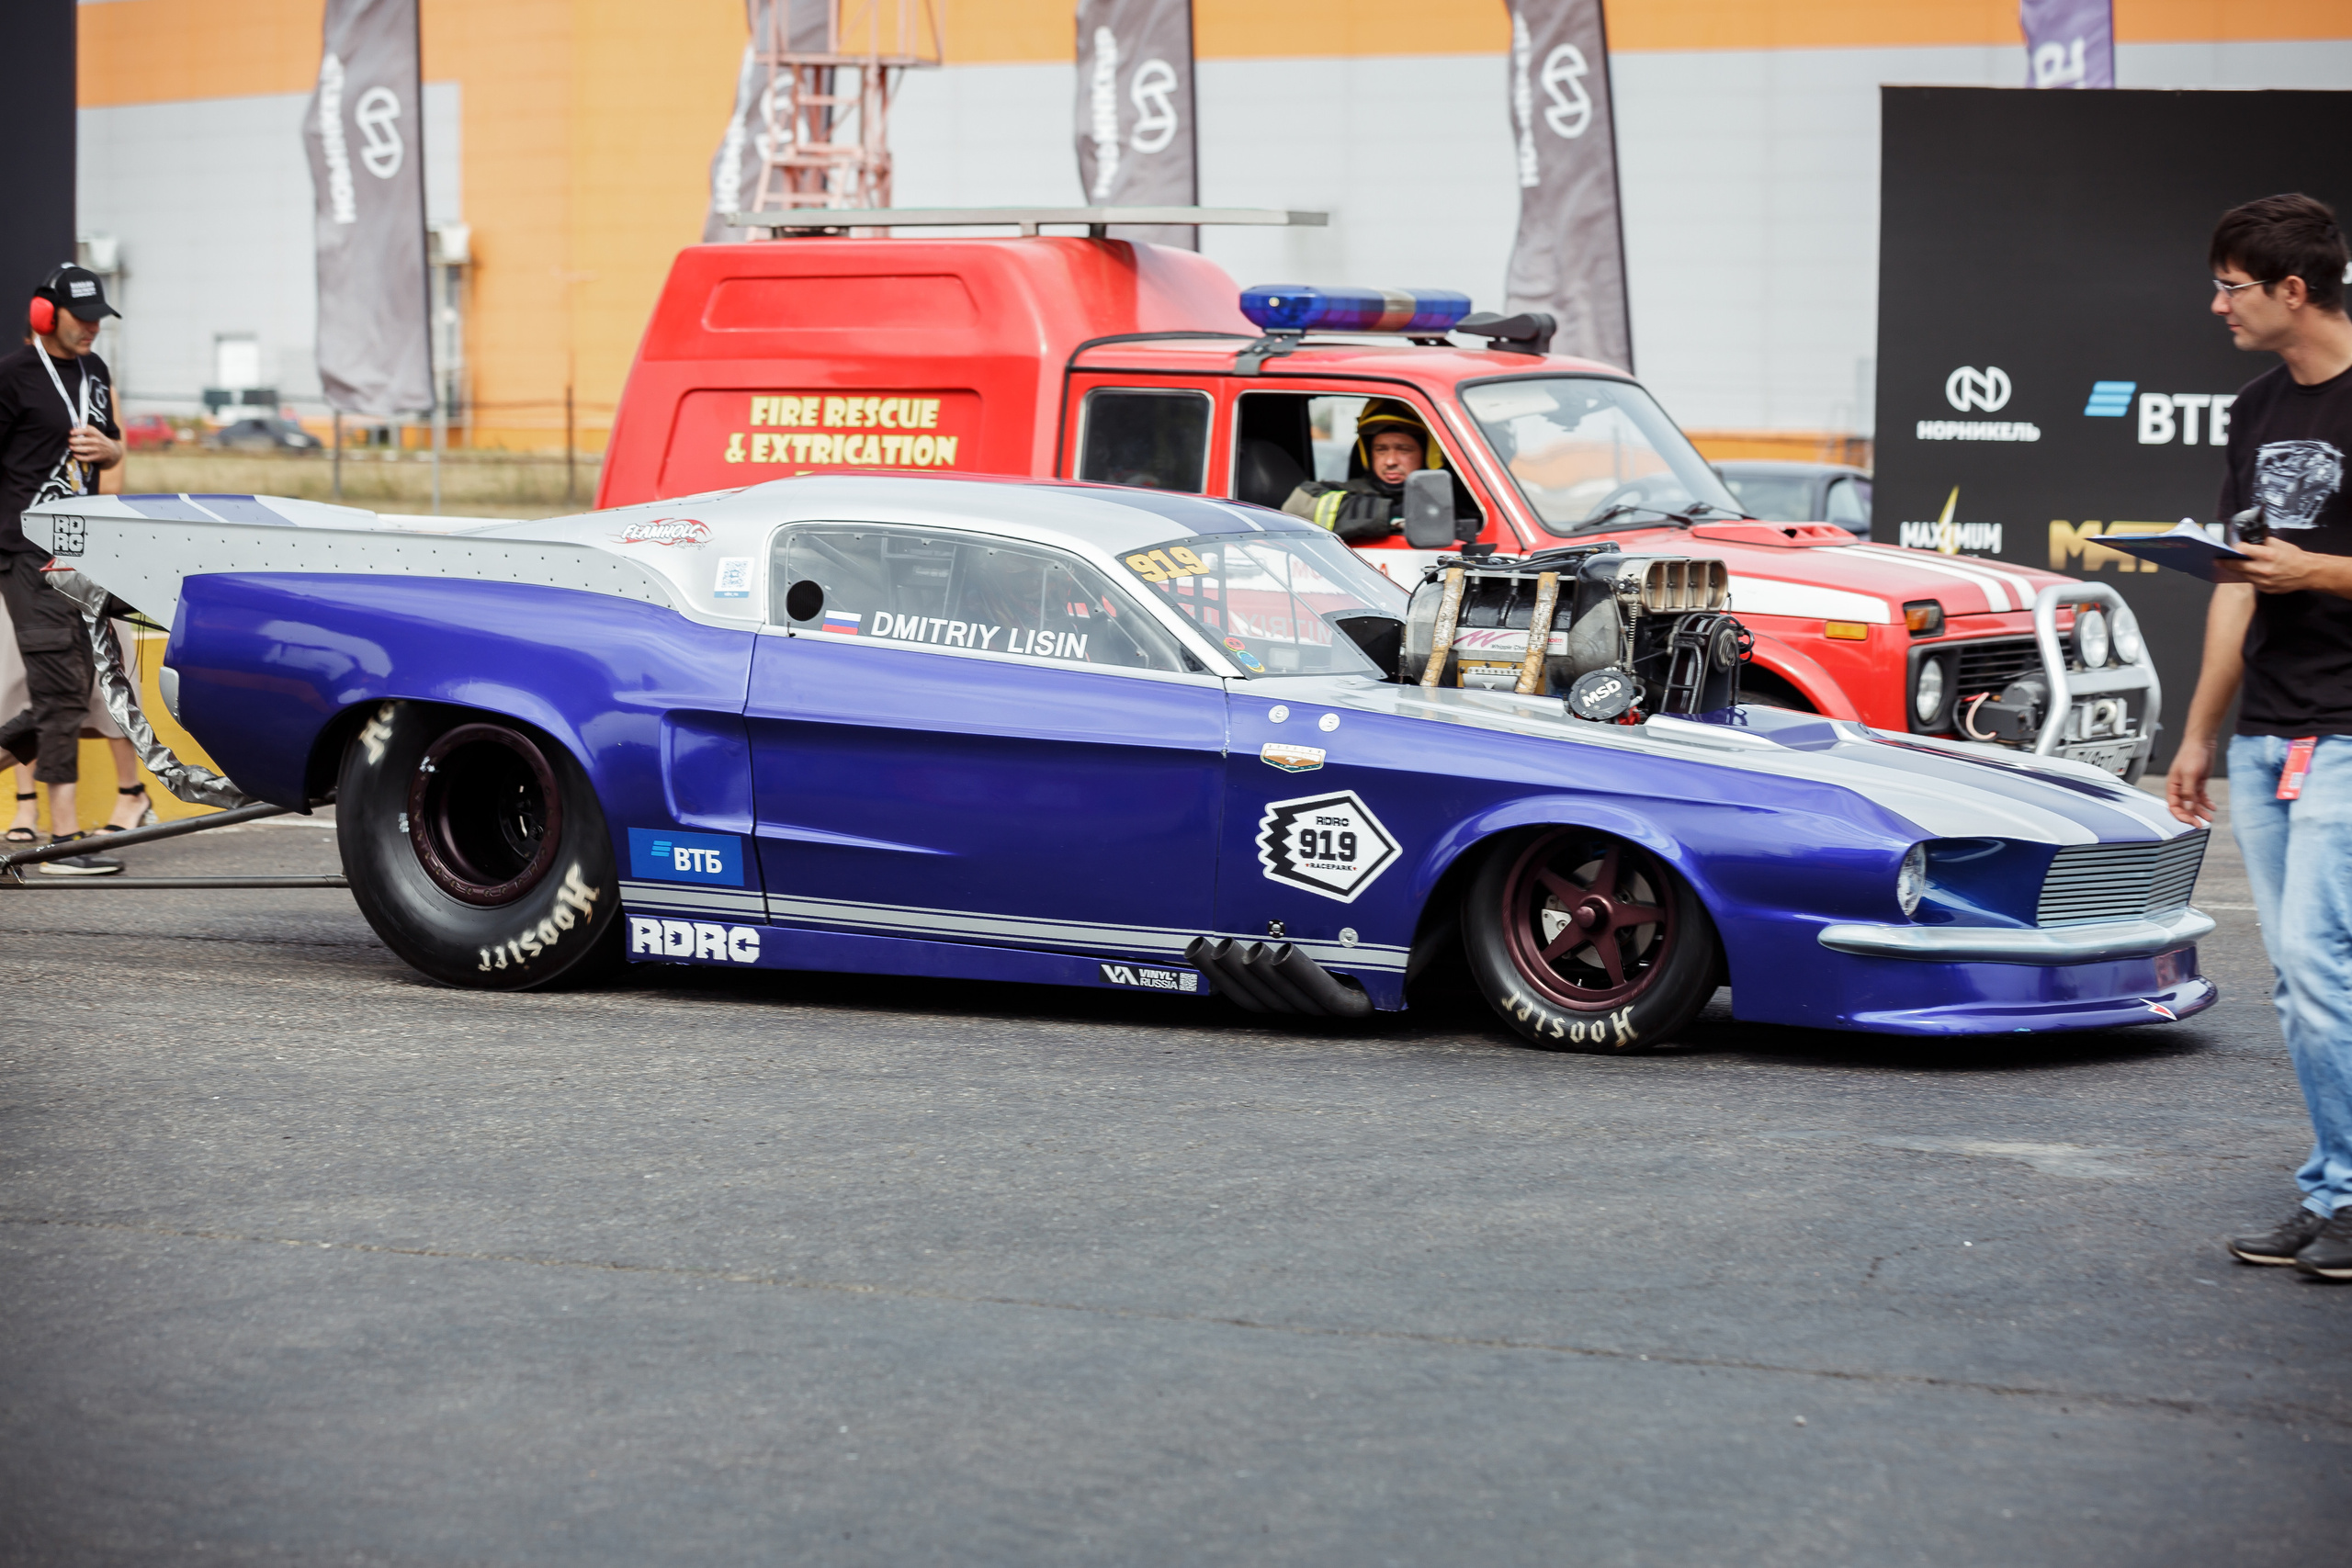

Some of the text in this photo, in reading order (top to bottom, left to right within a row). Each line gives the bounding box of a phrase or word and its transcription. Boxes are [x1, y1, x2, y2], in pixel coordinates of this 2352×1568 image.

[750, 395, 941, 429] FIRE RESCUE
[1917, 420, 2041, 442] НОРНИКЕЛЬ
[724, 432, 959, 467] & EXTRICATION
[1125, 546, 1210, 583] 919
[871, 611, 1089, 659] DMITRIY LISIN
[1581, 680, 1622, 707] MSD
[1316, 817, 1350, 827] RDRC
[673, 847, 723, 874] ВТБ
[1299, 829, 1357, 862] 919
[1310, 863, 1352, 871] RACEPARK
[478, 862, 600, 971] Hoosier
[629, 917, 760, 963] RDRC
[1138, 968, 1174, 980] VINYL
[1139, 977, 1179, 990] RUSSIA
[1501, 990, 1639, 1047] Hoosier
